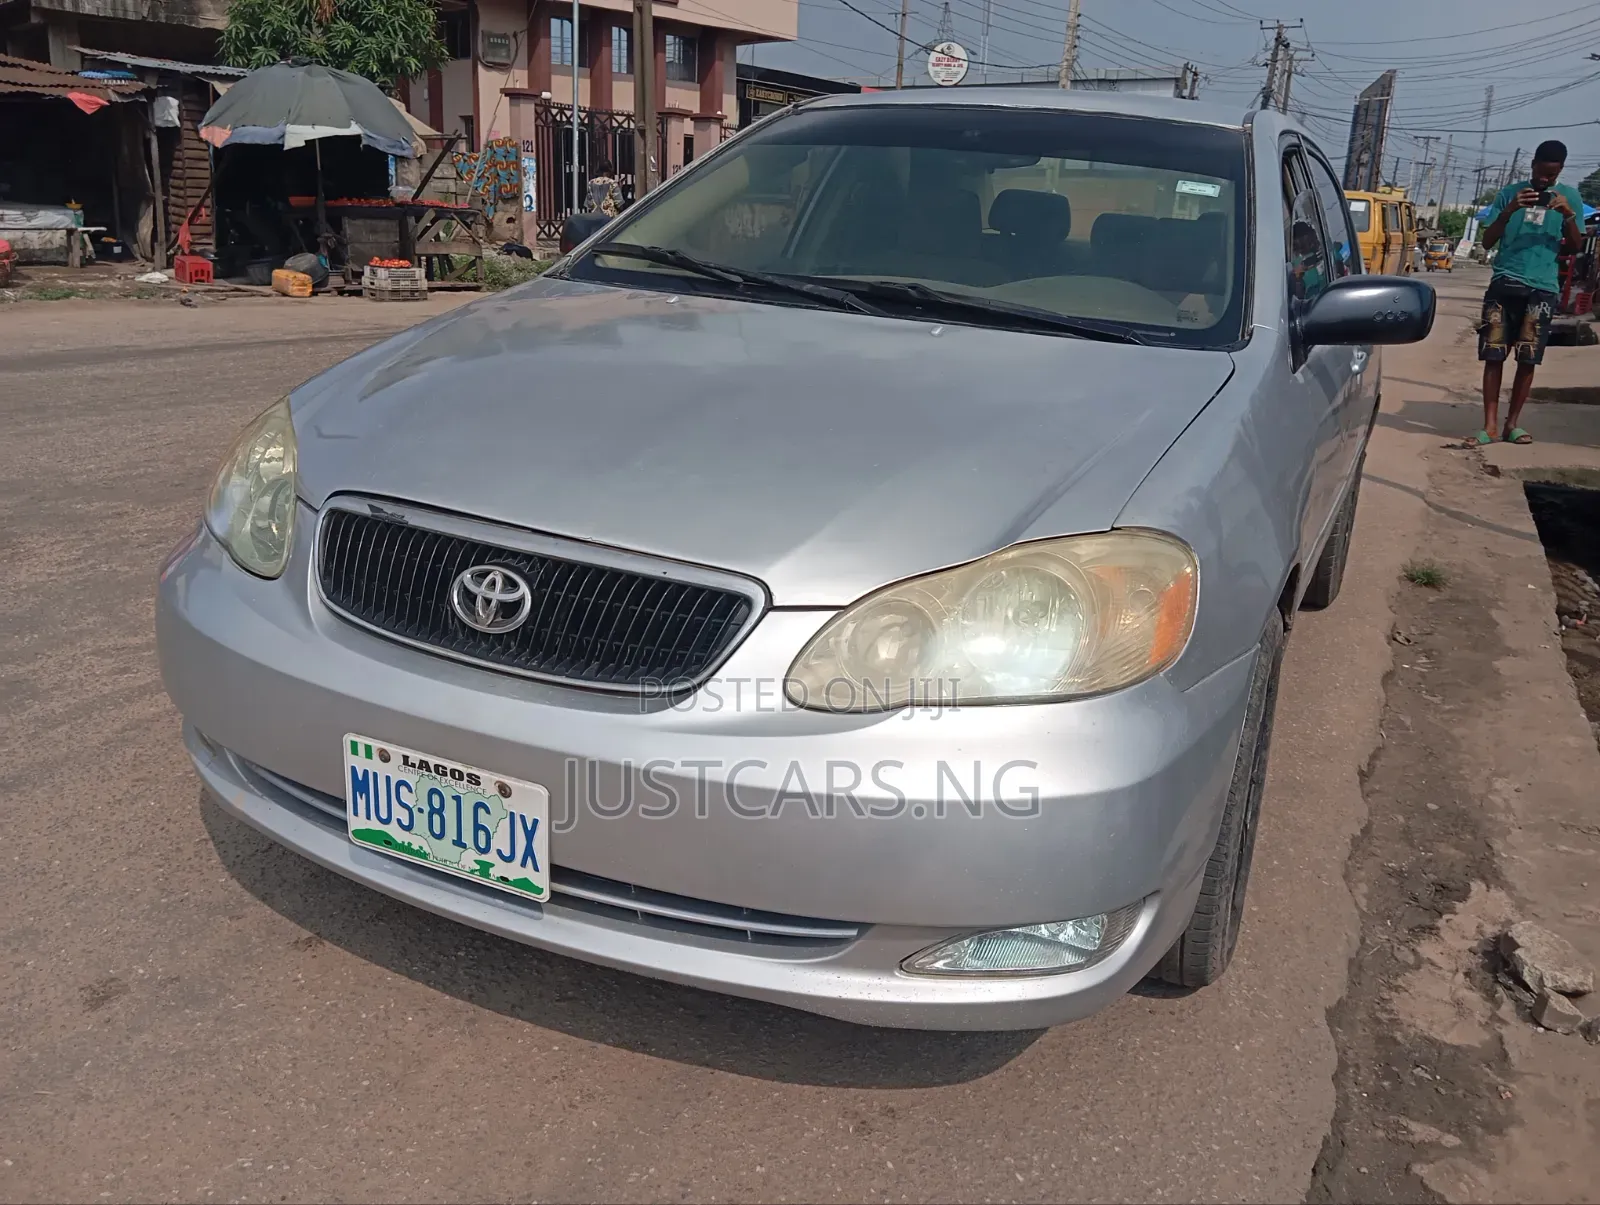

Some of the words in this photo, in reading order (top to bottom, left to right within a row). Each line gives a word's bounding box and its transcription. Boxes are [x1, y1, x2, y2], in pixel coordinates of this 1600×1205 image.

[523, 140, 533, 153] 121
[402, 754, 481, 786] LAGOS
[440, 777, 487, 796] EXCELLENCE
